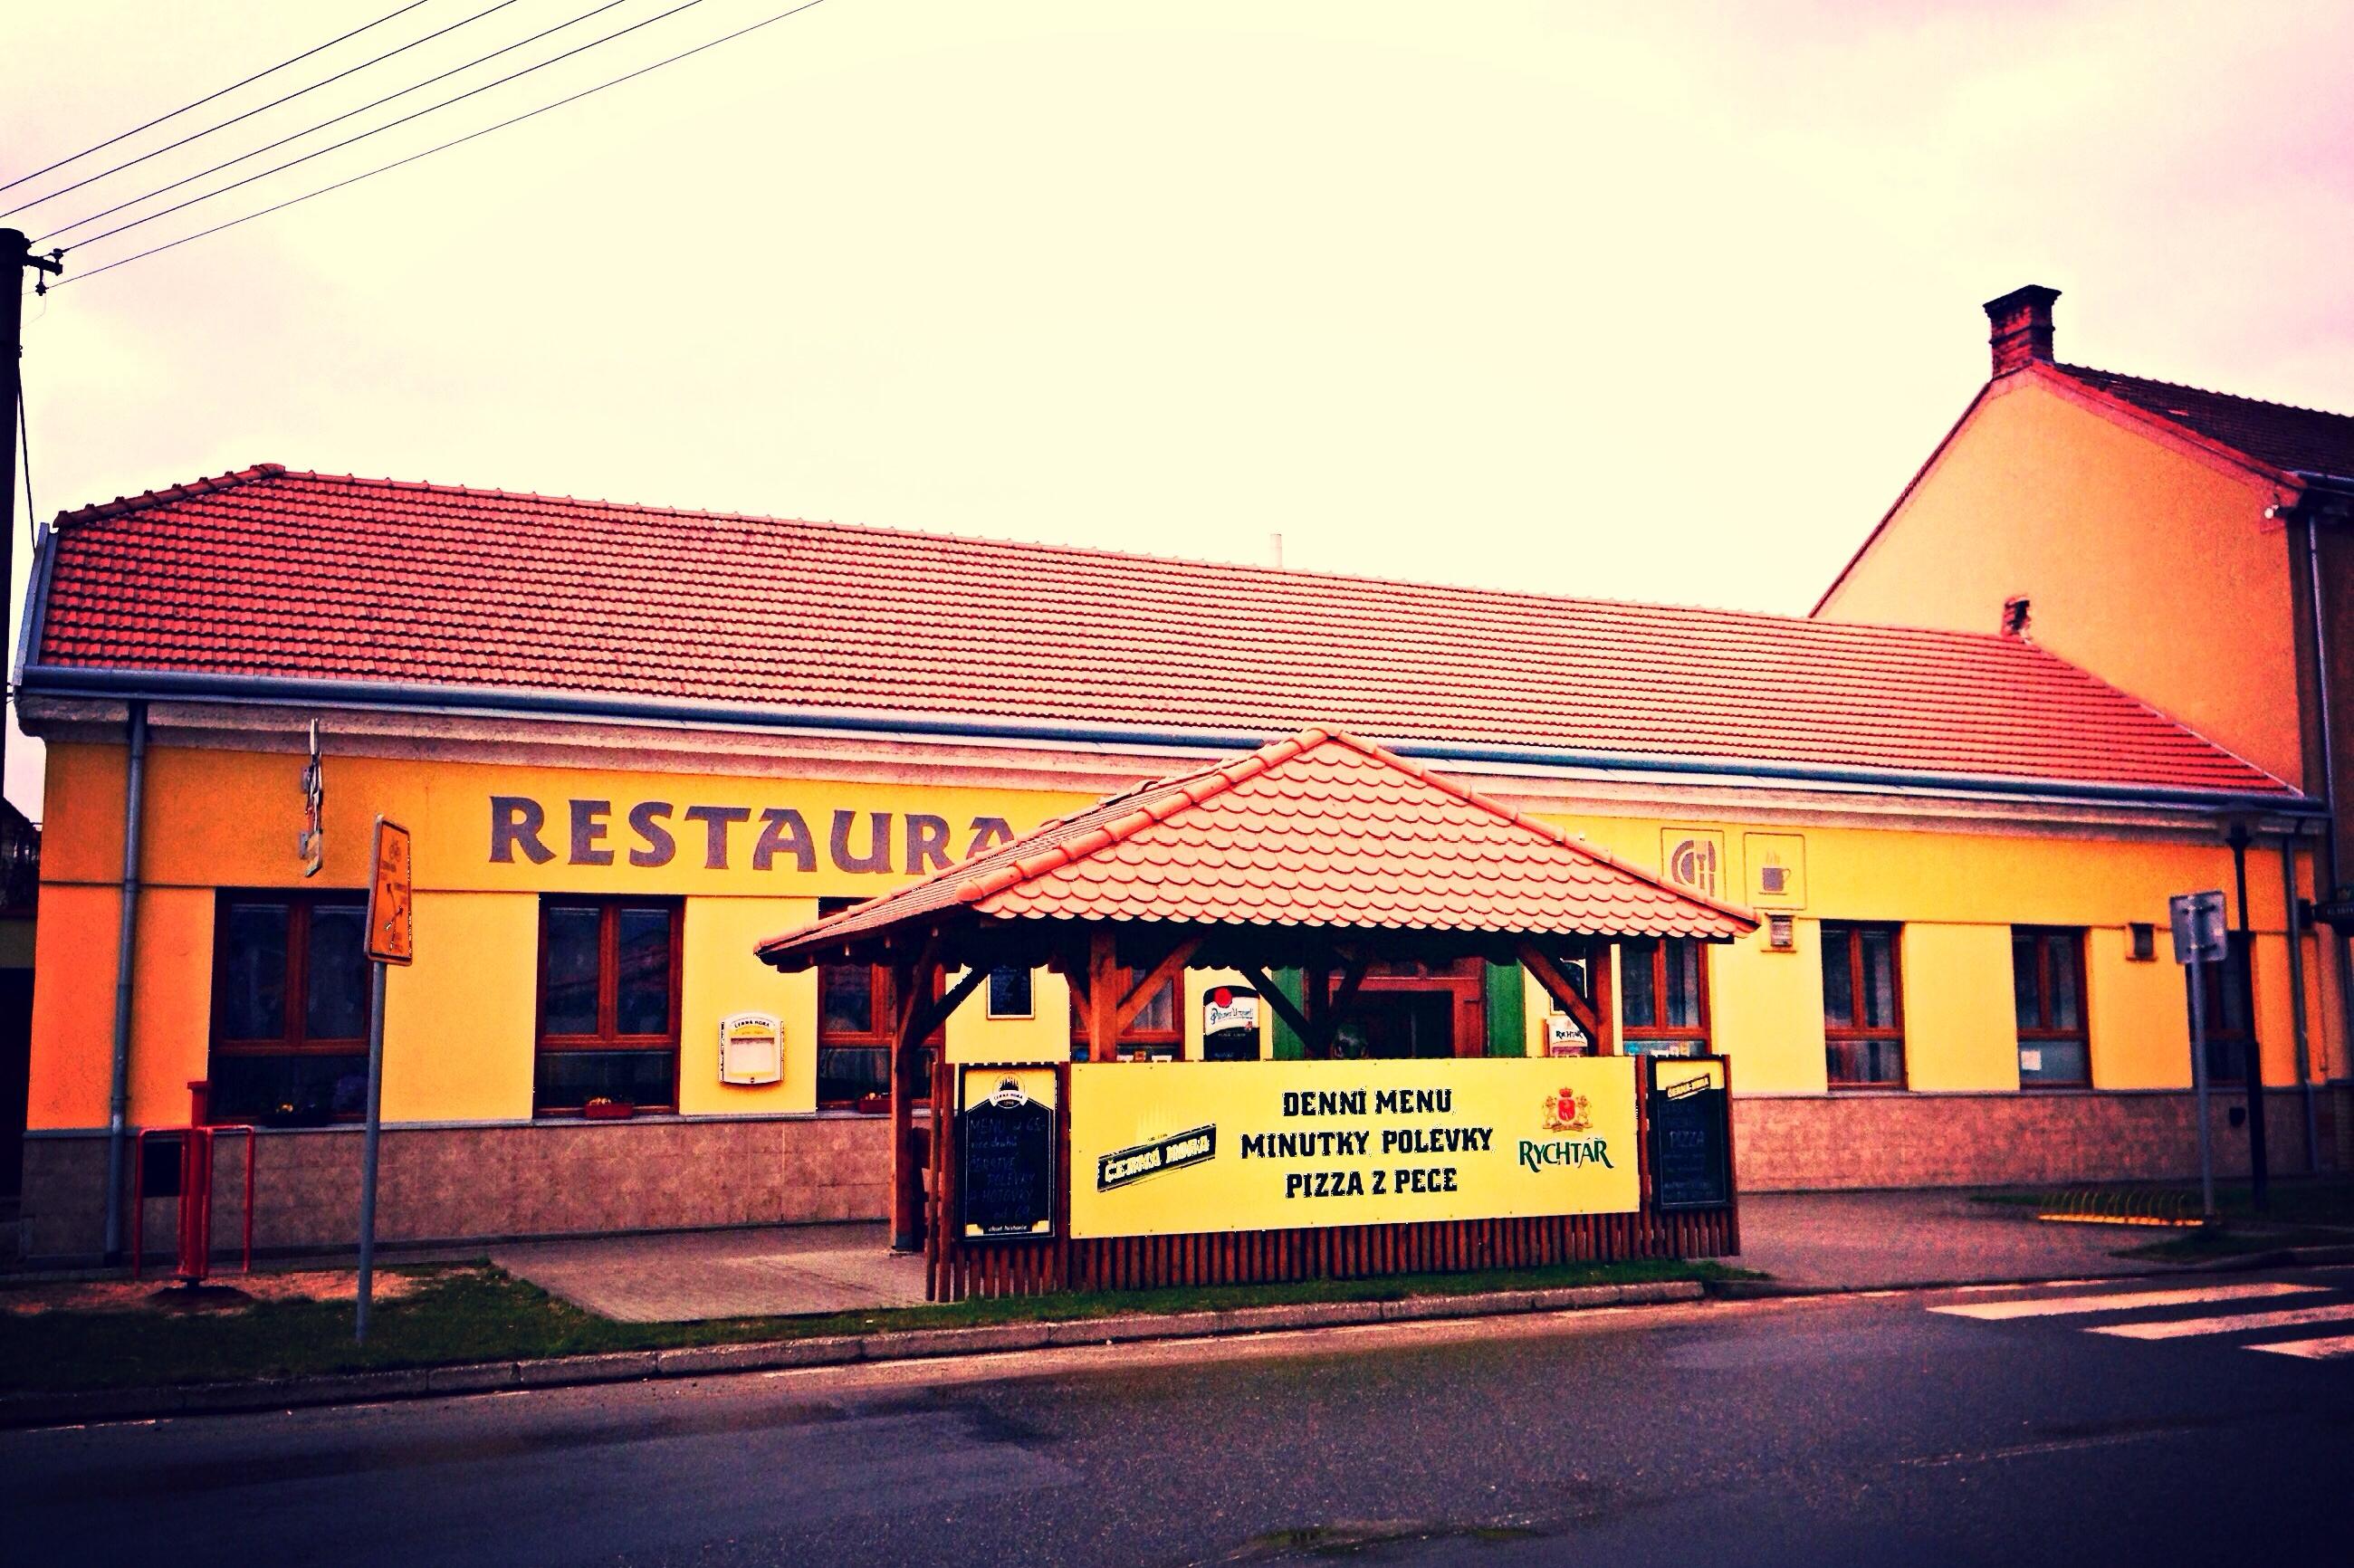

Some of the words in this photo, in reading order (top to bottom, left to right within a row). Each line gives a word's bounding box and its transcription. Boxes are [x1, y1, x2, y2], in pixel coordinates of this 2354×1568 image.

[1282, 1085, 1367, 1116] DENNÍ
[1286, 1171, 1364, 1199] PIZZA
[1372, 1170, 1387, 1195] Z
[1394, 1167, 1458, 1194] PECE
